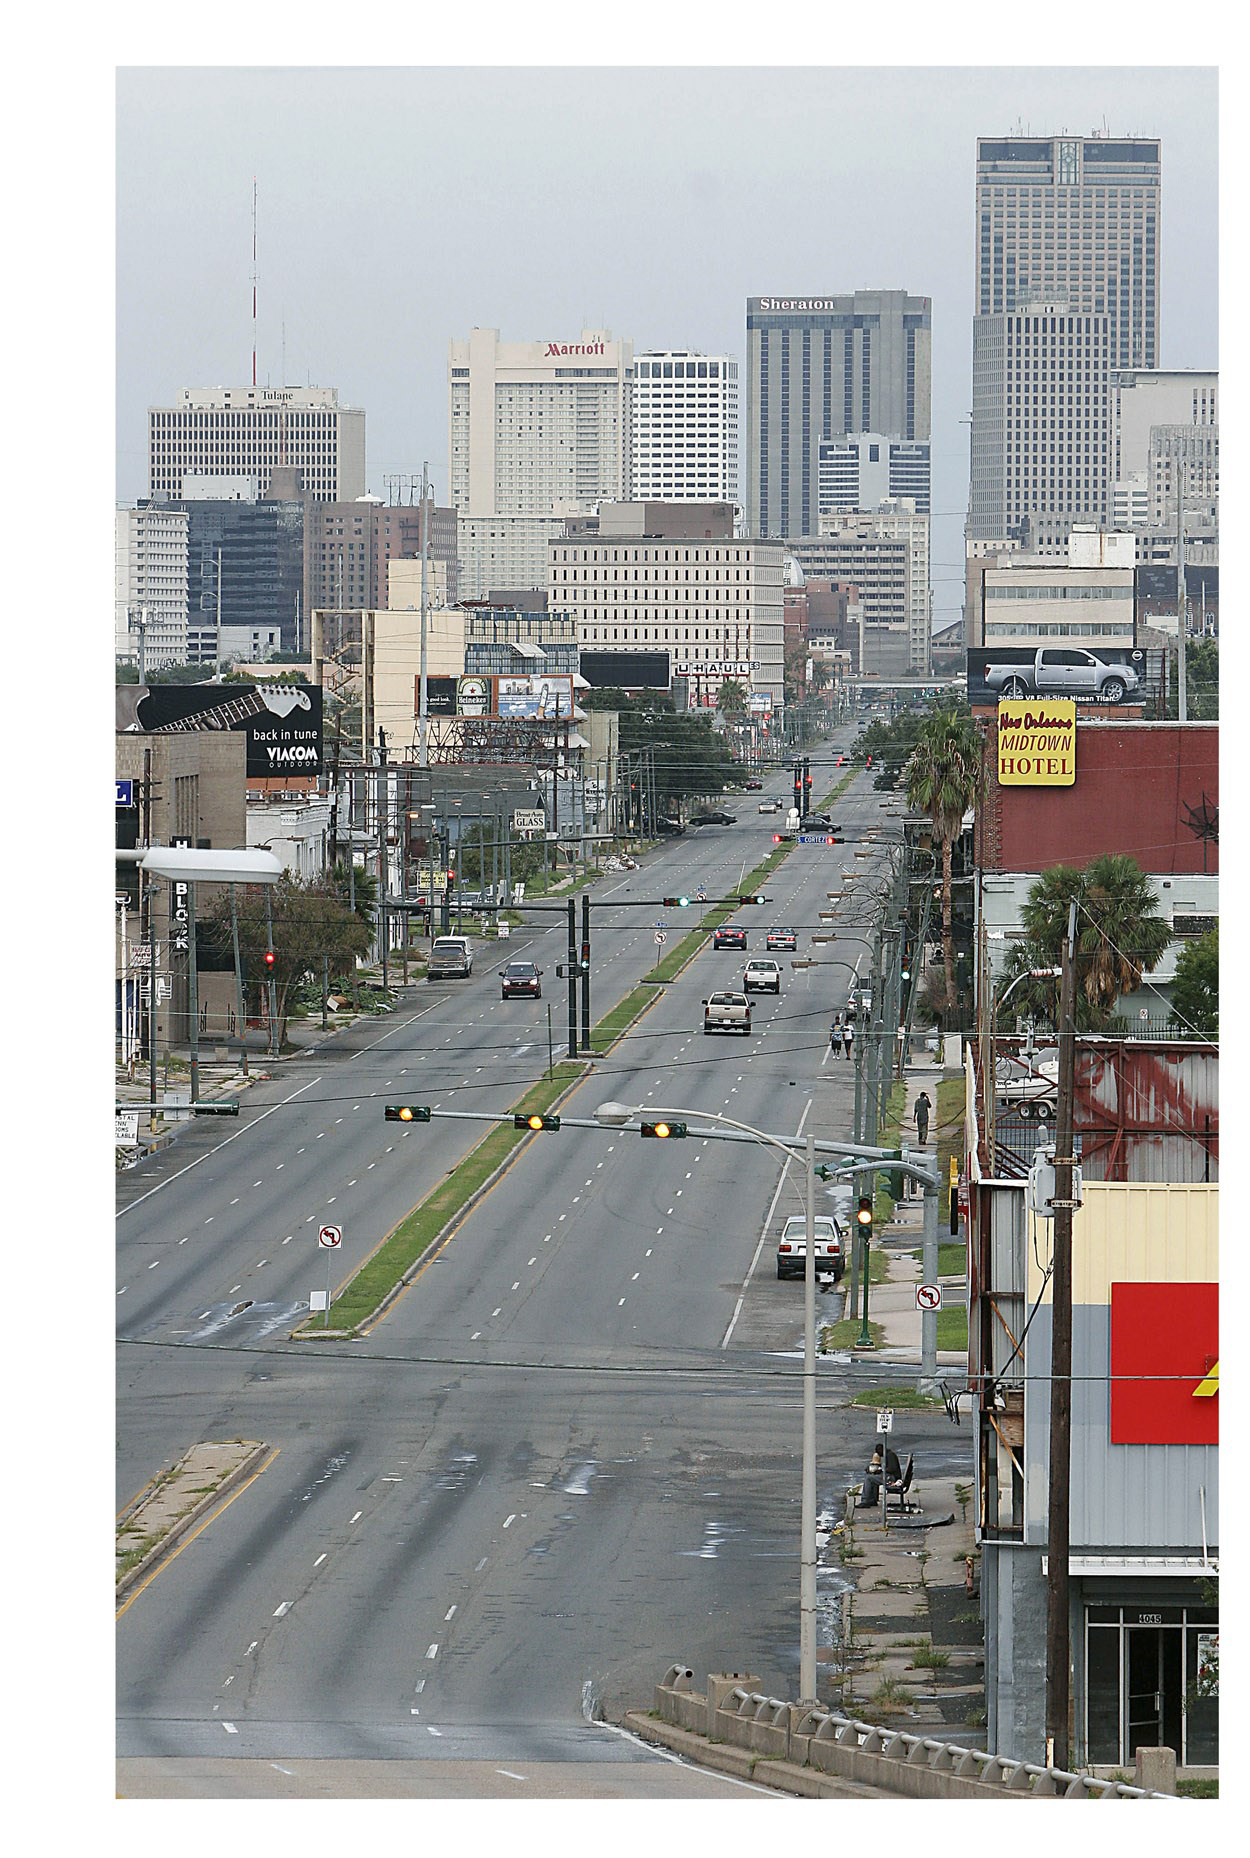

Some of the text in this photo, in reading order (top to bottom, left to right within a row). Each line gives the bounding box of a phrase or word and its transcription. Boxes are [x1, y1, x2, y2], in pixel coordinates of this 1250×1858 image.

[760, 298, 834, 310] Sheraton
[544, 343, 605, 357] Marriott
[261, 391, 294, 400] Tulane
[1001, 711, 1073, 731] New Orleans
[253, 729, 318, 741] back in tune
[1001, 735, 1072, 751] MIDTOWN
[266, 746, 318, 761] VIACOM
[1000, 758, 1073, 775] HOTEL
[516, 817, 544, 827] GLASS
[1139, 1614, 1161, 1623] 4045
